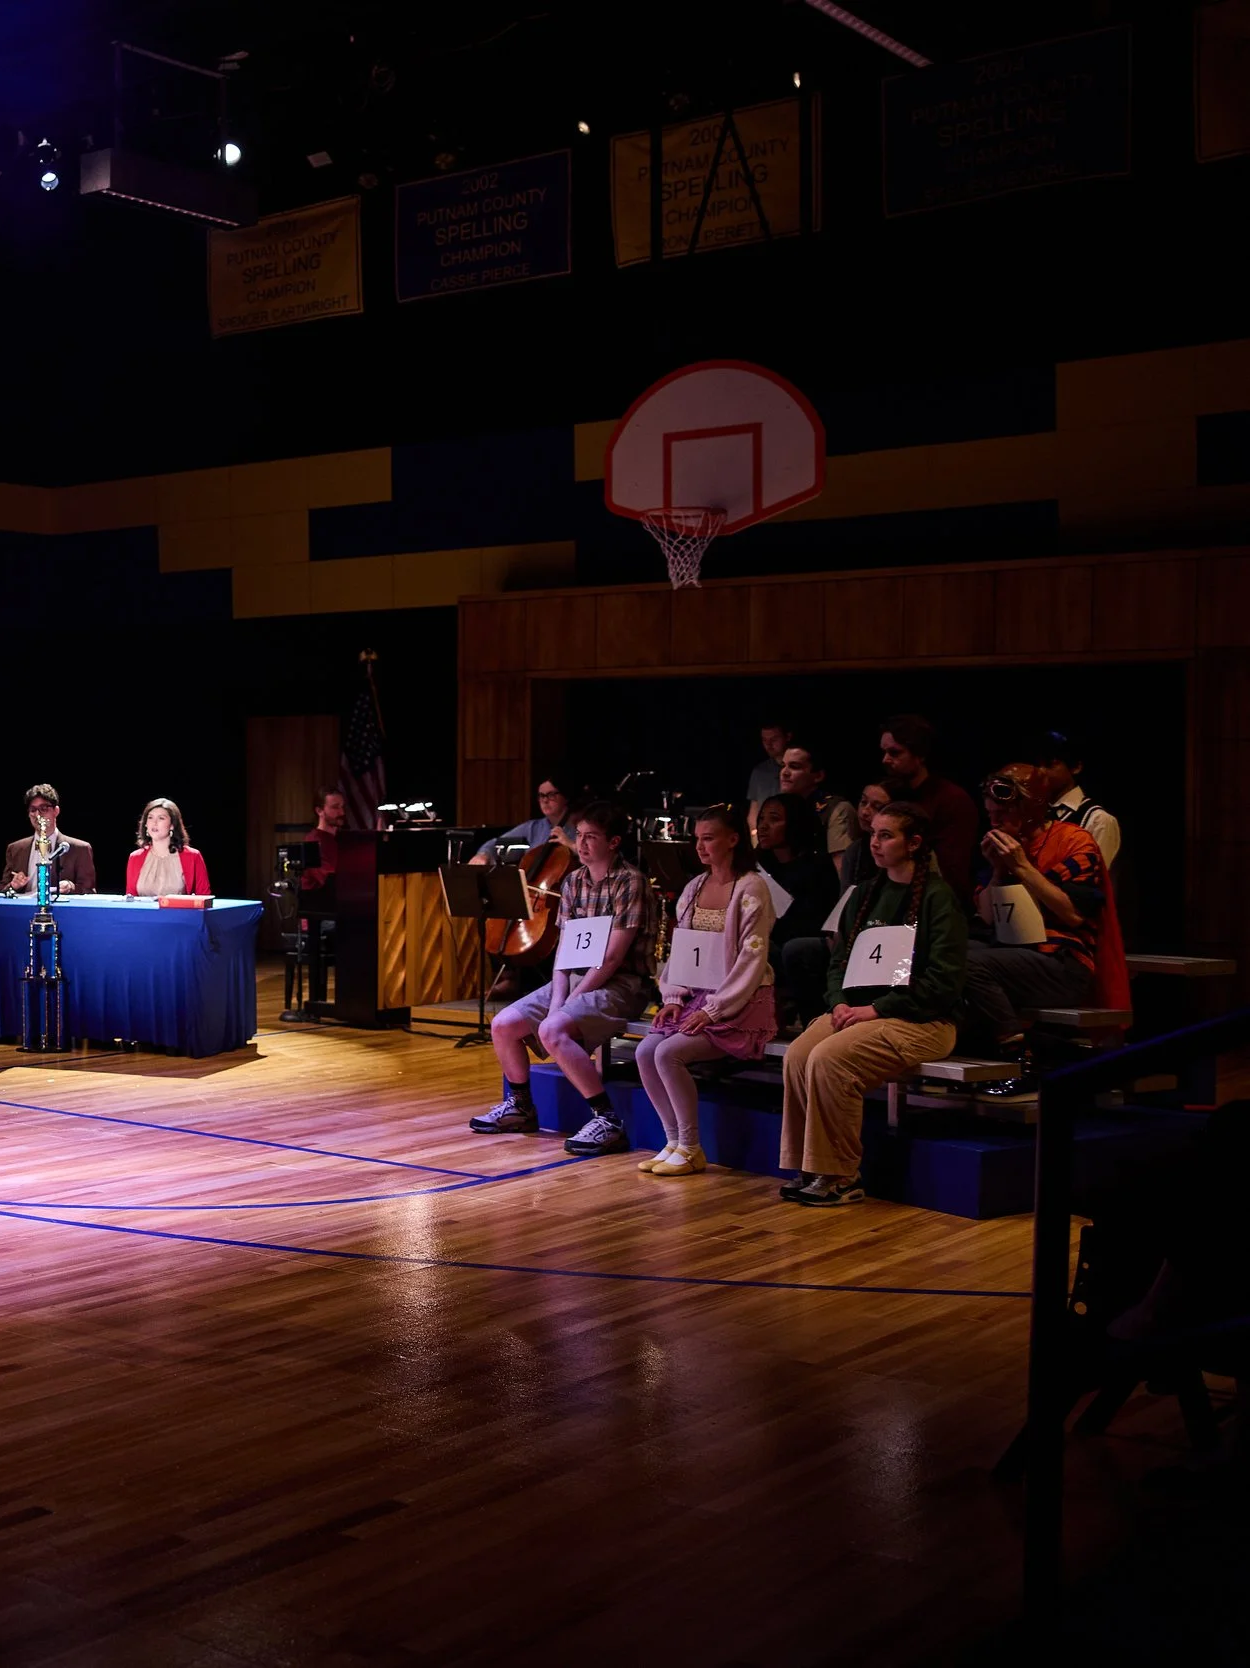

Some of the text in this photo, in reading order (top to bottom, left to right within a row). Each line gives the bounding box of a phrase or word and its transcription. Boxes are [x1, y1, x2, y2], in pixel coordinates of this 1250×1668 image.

[689, 123, 731, 146] 200
[638, 153, 711, 181] PTNAM
[459, 172, 499, 195] 2002
[416, 186, 548, 226] PUTNAM COUNTY
[435, 211, 529, 247] SPELLING
[227, 230, 338, 265] PUTNAM COUNTY
[440, 238, 522, 268] CHAMPION
[242, 252, 323, 284] SPELLING
[430, 262, 531, 291] CASSIE PIERCE
[247, 278, 317, 304] CHAMPION
[992, 902, 1015, 924] 17
[575, 932, 592, 950] 13
[869, 943, 882, 964] 4
[693, 947, 700, 967] 1
